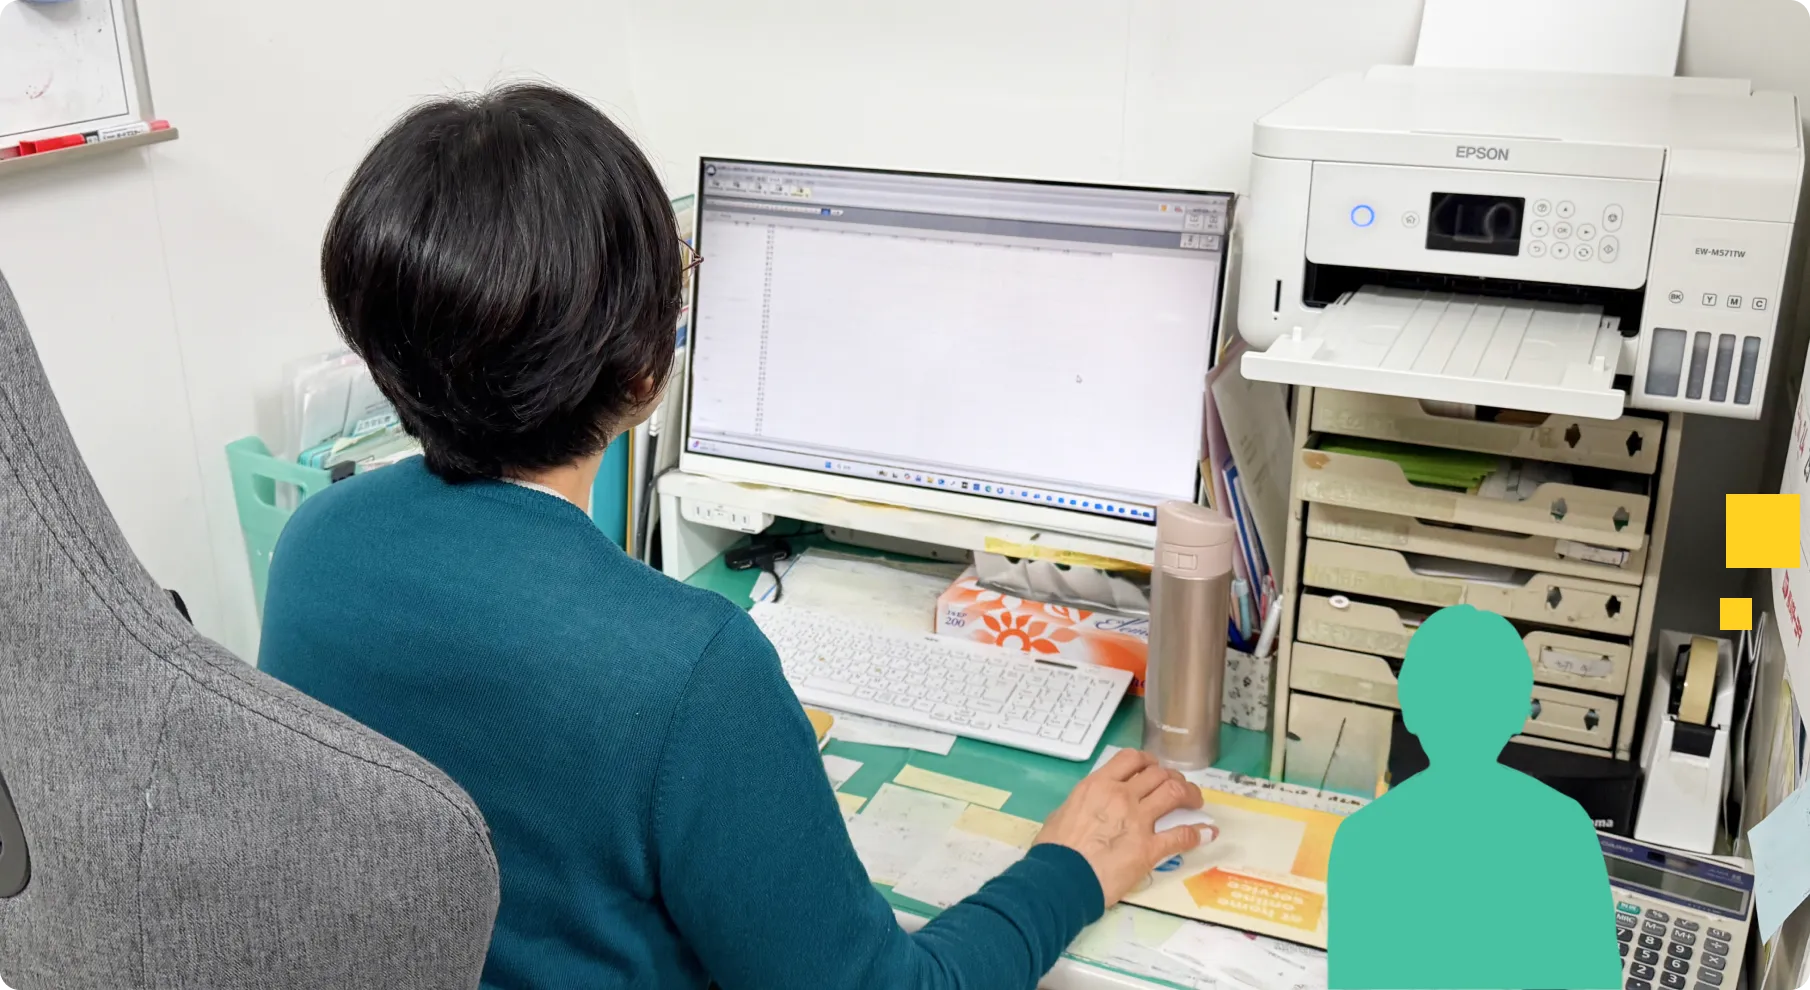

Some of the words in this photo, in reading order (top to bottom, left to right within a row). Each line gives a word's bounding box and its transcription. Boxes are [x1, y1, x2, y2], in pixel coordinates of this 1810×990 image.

[1456, 146, 1509, 161] EPSON
[1695, 247, 1746, 258] EW-M571TW
[1730, 298, 1738, 306] M
[1755, 300, 1763, 308] C
[945, 616, 965, 628] 200
[1226, 880, 1305, 905] service
[1230, 890, 1296, 912] online
[1217, 897, 1275, 919] home
[1617, 928, 1626, 937] 7
[1645, 936, 1655, 945] 8
[1675, 945, 1685, 954] 9
[1642, 950, 1651, 959] 5
[1637, 964, 1647, 974] 2
[1671, 960, 1681, 969] 6
[1668, 974, 1678, 983] 3
